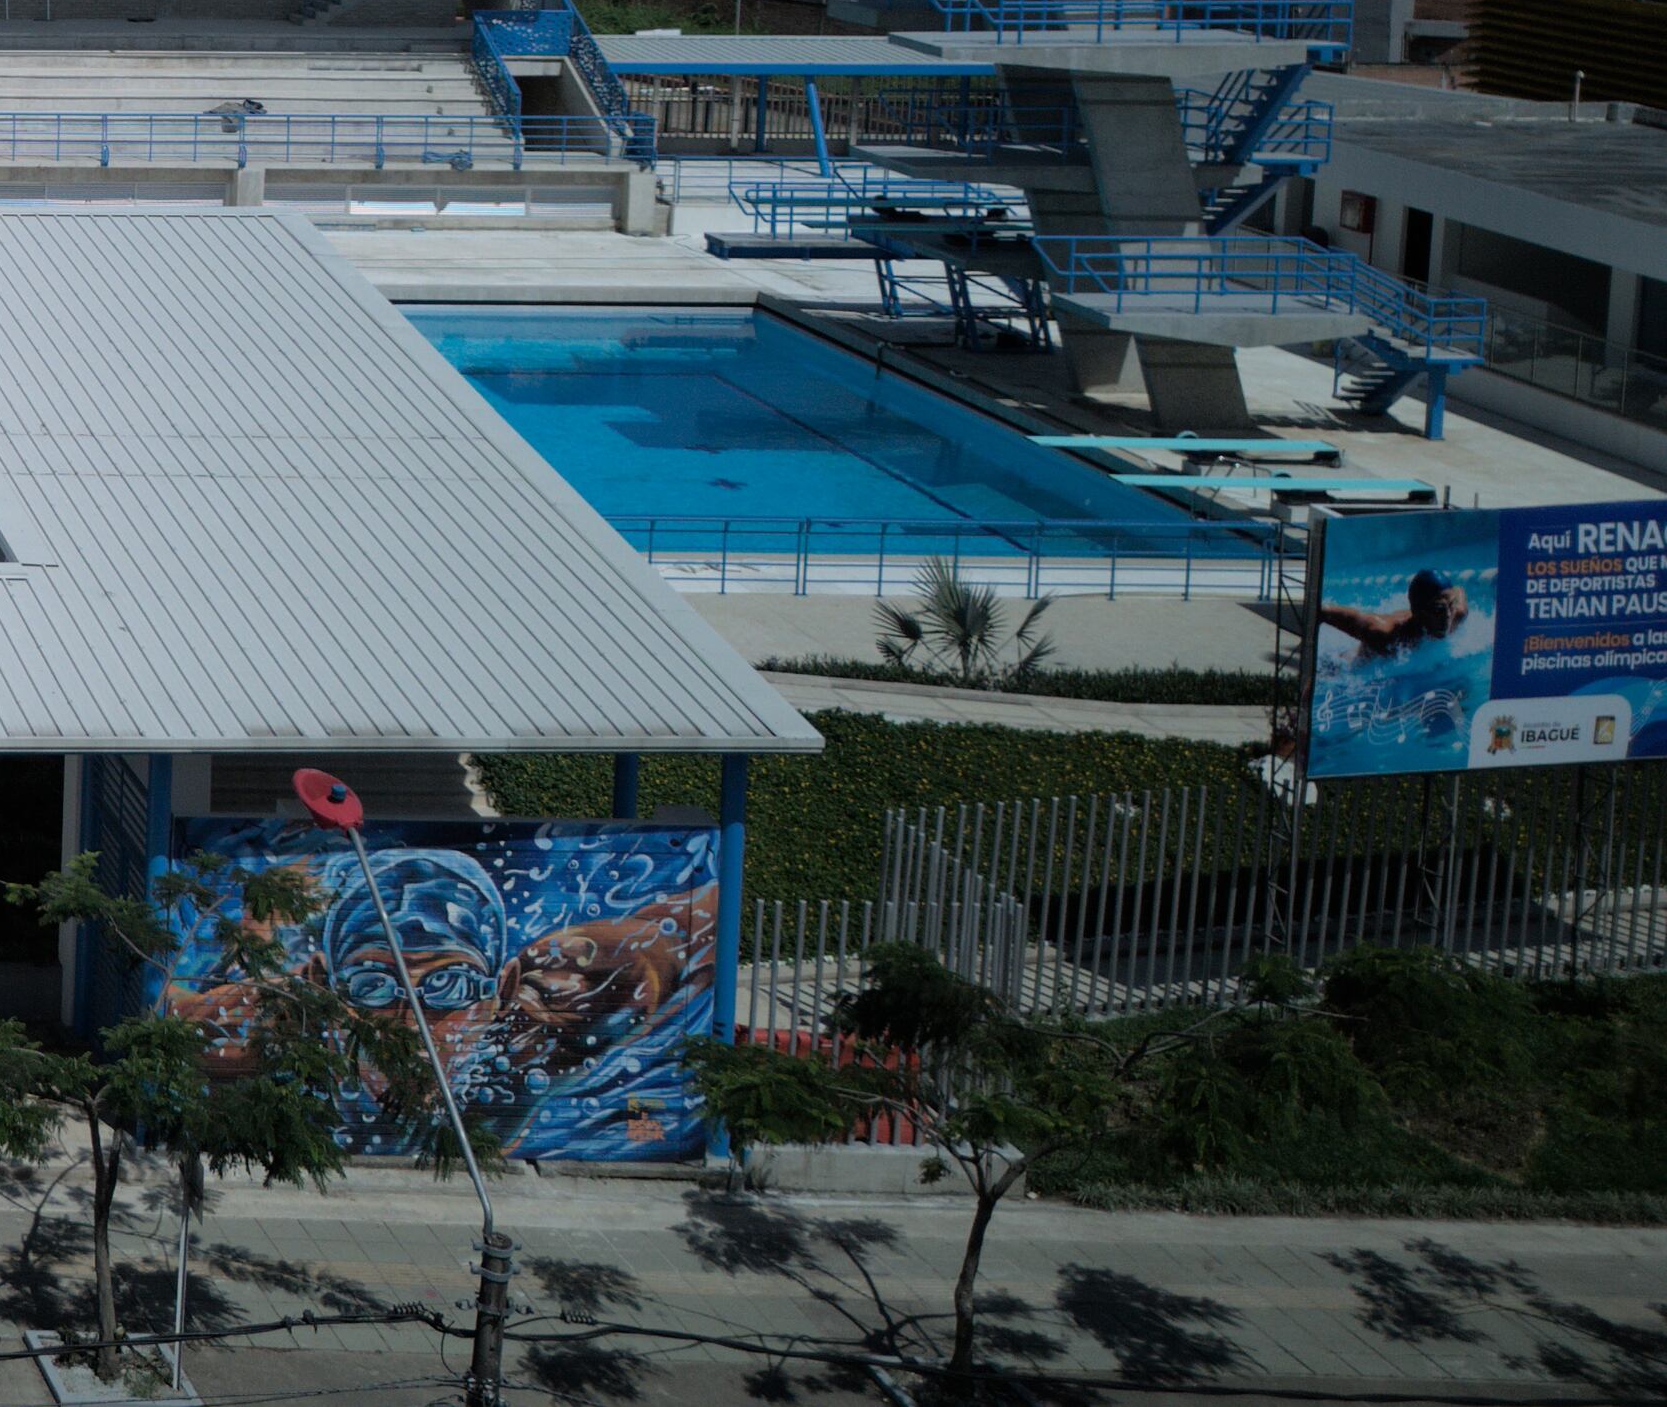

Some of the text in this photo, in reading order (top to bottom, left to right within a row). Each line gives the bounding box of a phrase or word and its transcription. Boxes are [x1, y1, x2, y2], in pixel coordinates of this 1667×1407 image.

[1578, 519, 1667, 554] RENA
[1527, 561, 1557, 576] LOS
[1560, 555, 1623, 575] SUEÑOS
[1625, 555, 1658, 573] QUE
[1526, 573, 1656, 594] DE DEPORTISTAS
[1525, 590, 1607, 619] TENÍAN
[1523, 631, 1629, 653] ¡Bienvenidos
[1633, 632, 1644, 645] a
[1521, 653, 1591, 676] piscinas
[1520, 723, 1581, 743] IBAGUÉ
